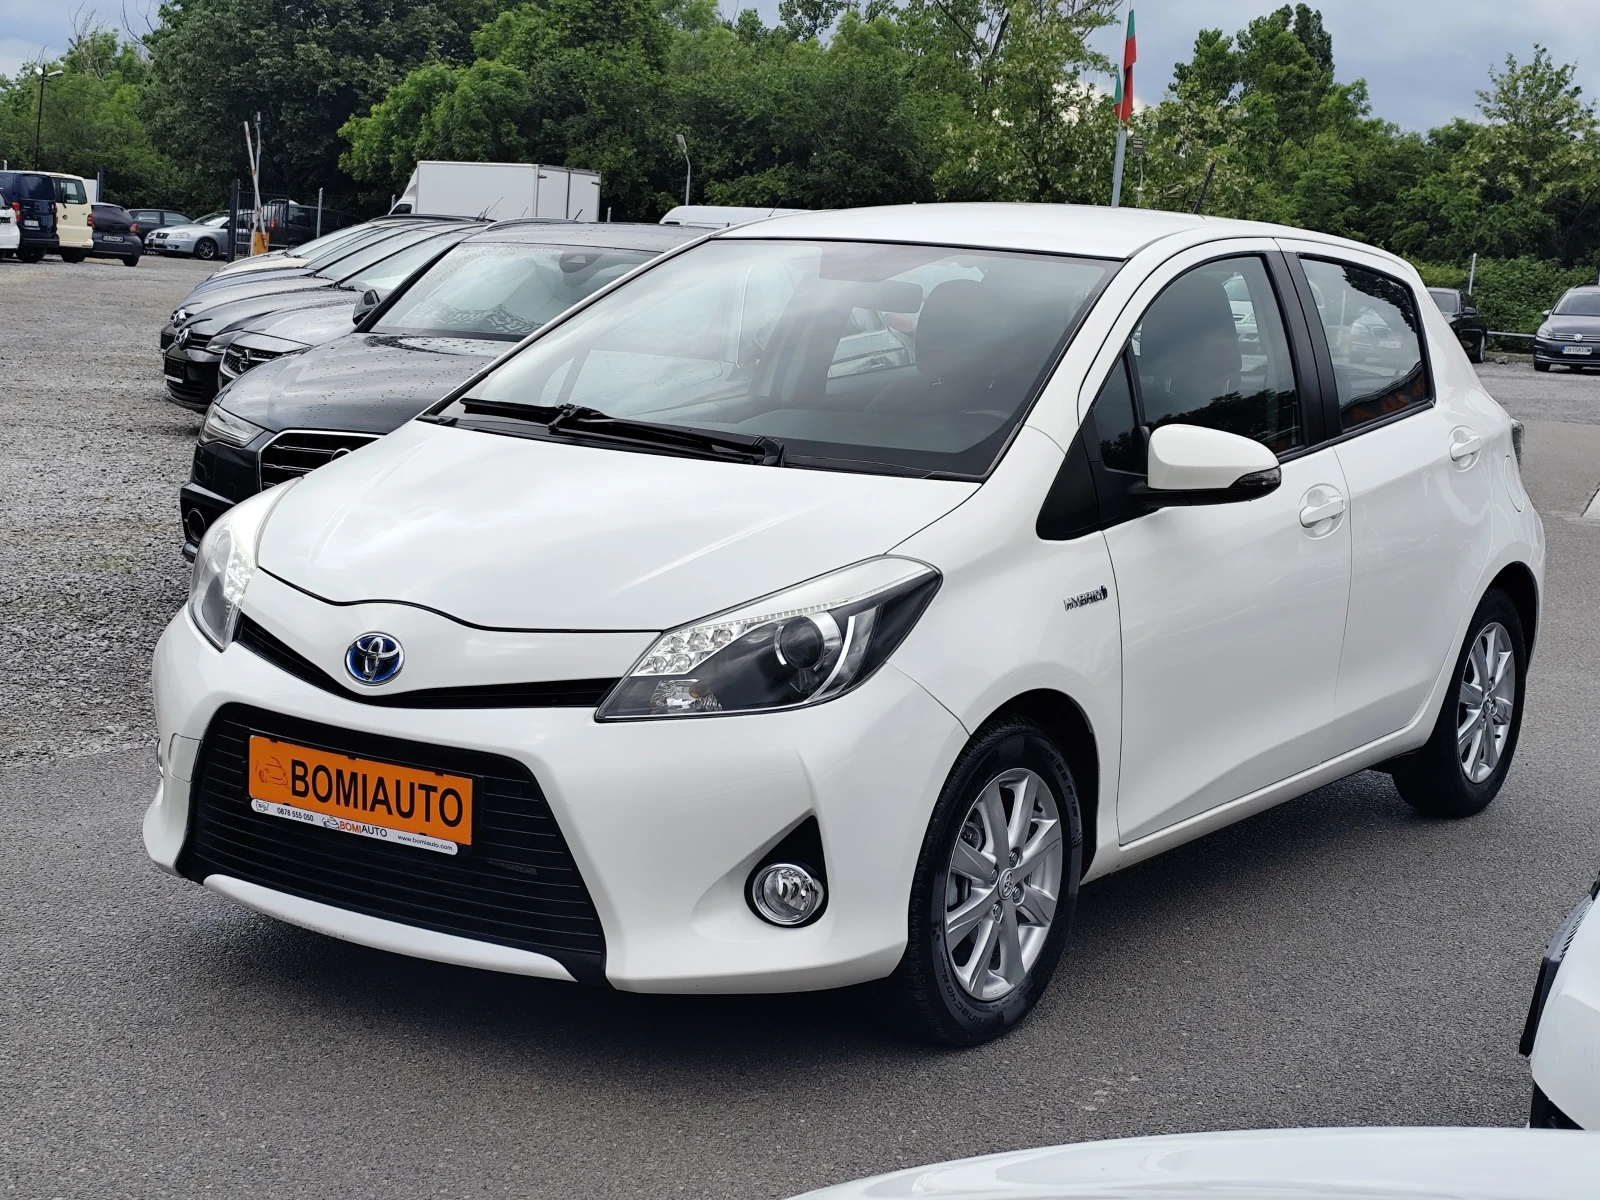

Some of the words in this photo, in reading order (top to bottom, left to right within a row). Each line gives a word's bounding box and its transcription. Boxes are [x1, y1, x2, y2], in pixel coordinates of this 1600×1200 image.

[1063, 588, 1102, 611] HYBRID
[291, 758, 463, 828] BOMIAUTO
[277, 806, 291, 817] 0878
[291, 811, 302, 819] 555
[303, 813, 314, 822] 050
[339, 820, 388, 838] BOMIAUTO
[398, 834, 453, 851] www.bomiauto.com
